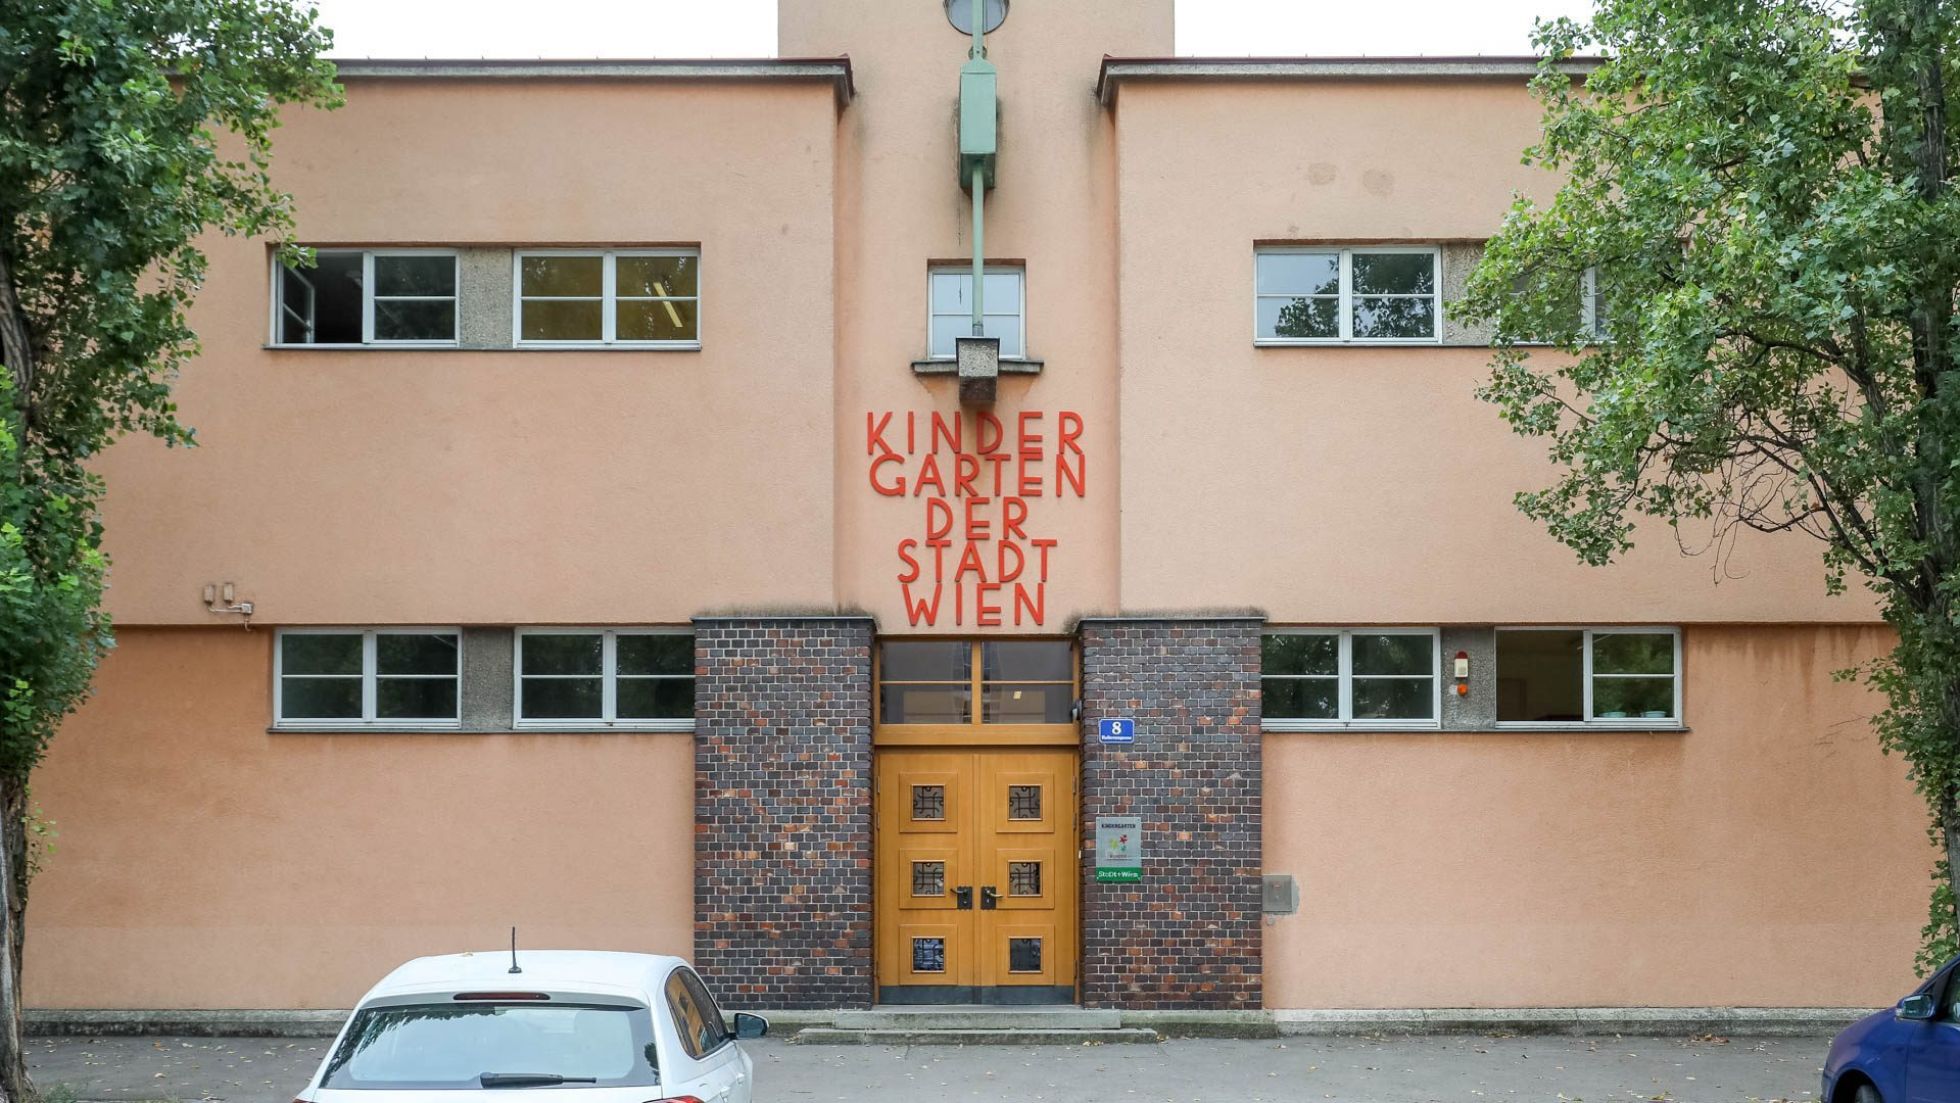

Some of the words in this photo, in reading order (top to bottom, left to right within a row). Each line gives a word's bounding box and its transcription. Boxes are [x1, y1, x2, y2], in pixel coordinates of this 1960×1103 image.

[867, 411, 1083, 455] KINDER
[869, 453, 1085, 497] GARTEN
[927, 496, 1028, 540] DER
[897, 539, 1057, 583] STADT
[902, 582, 1044, 626] WIEN
[1111, 721, 1122, 735] 8
